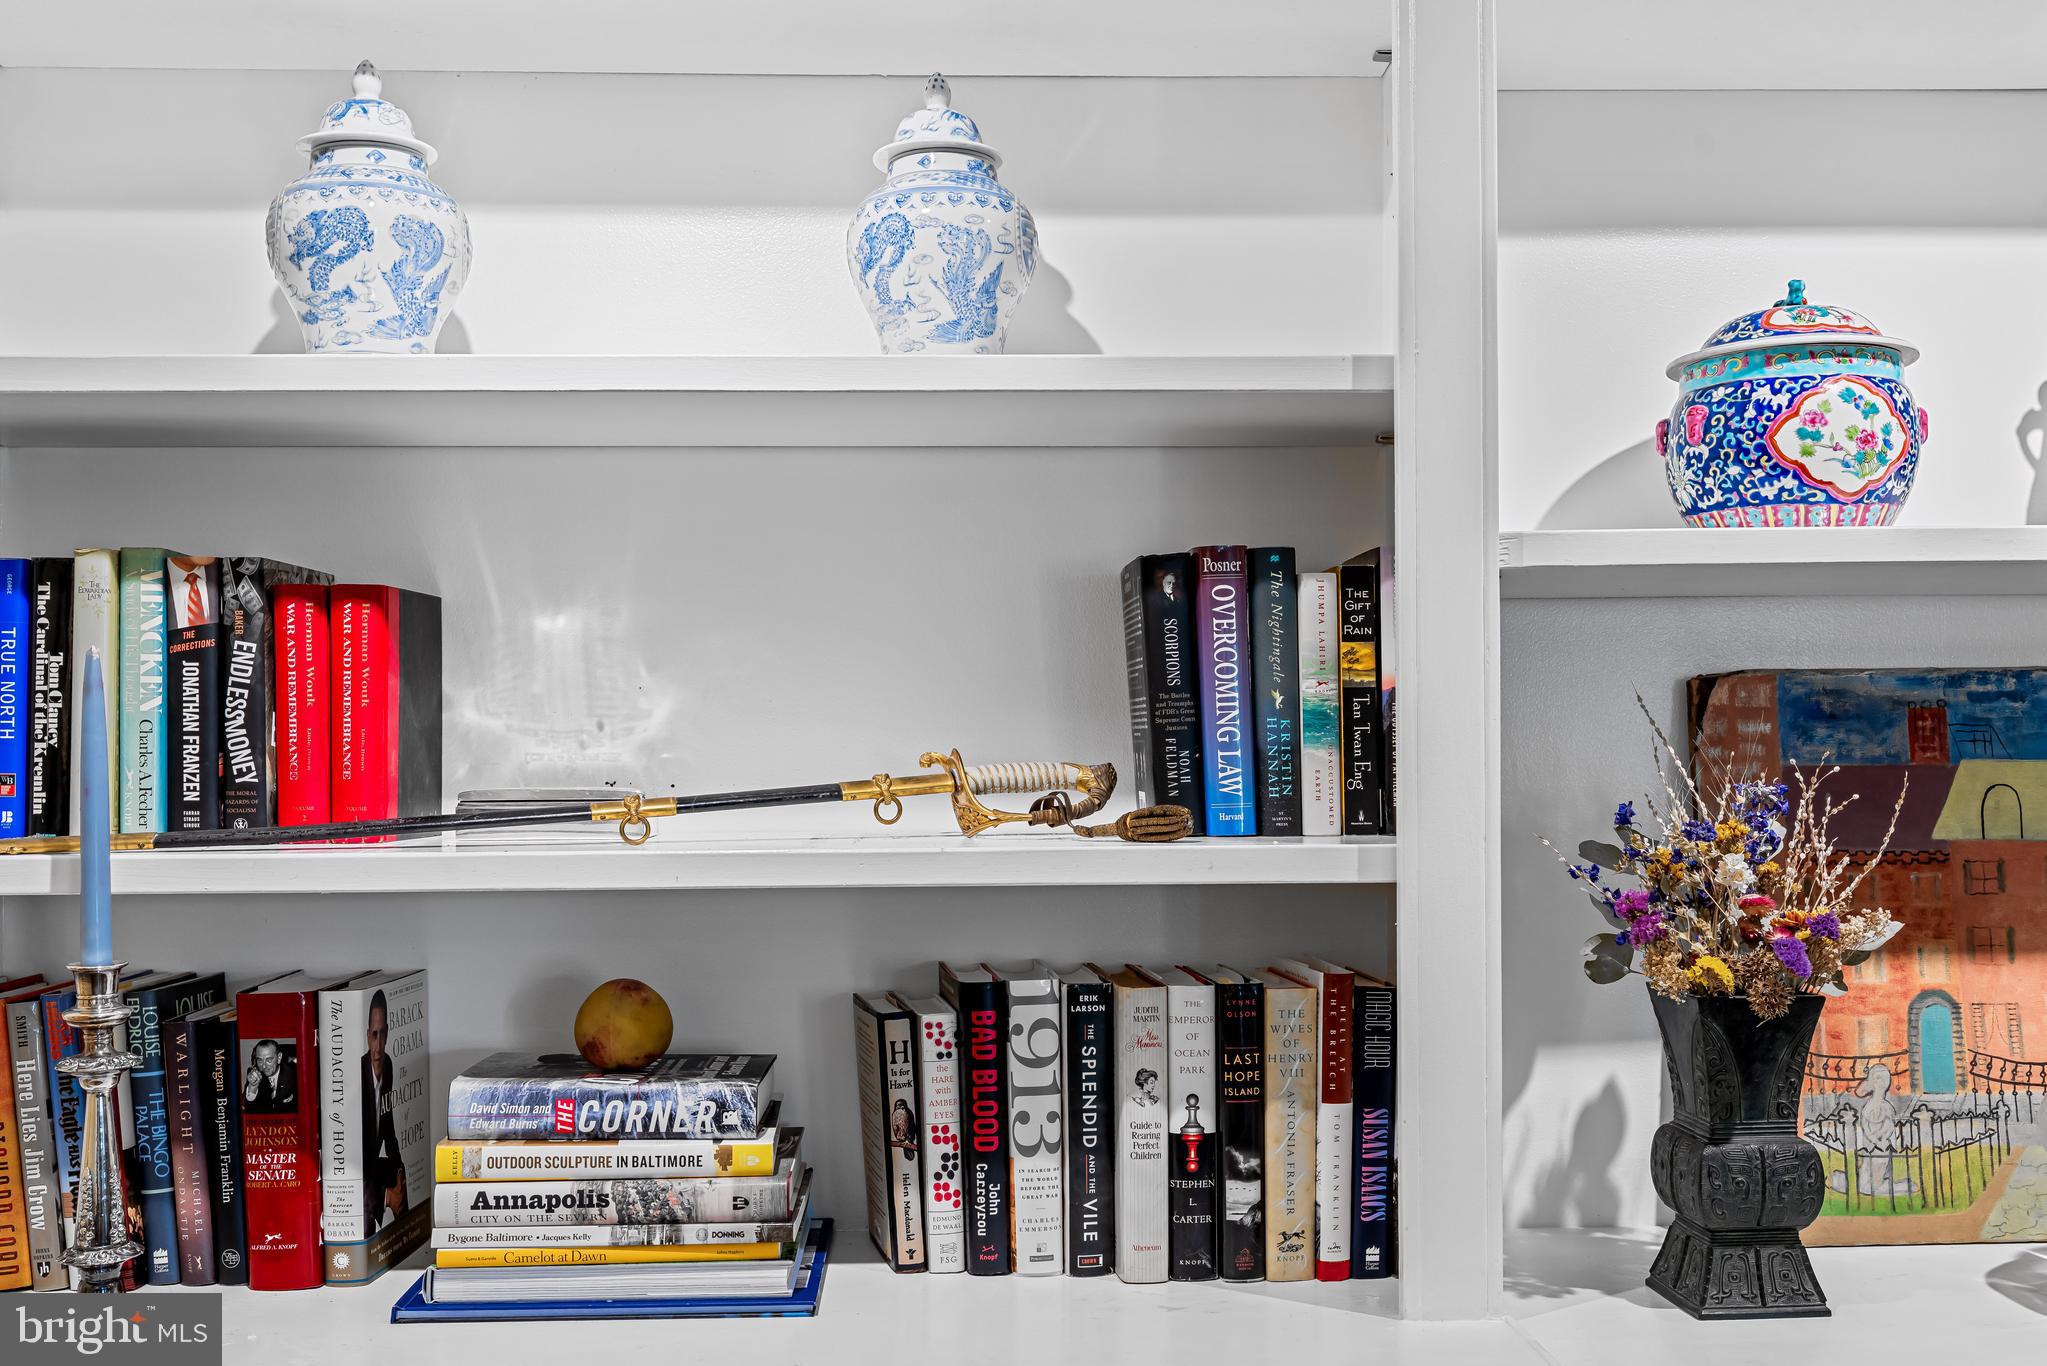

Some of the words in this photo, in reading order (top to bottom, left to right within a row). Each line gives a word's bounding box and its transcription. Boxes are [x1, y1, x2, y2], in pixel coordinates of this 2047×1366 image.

[1202, 557, 1242, 573] Posner
[37, 581, 50, 615] The
[1270, 571, 1283, 598] The
[1346, 588, 1369, 599] THE
[287, 603, 295, 635] WAR
[343, 603, 352, 635] WAR
[1344, 601, 1371, 611] GIFT
[1351, 615, 1365, 623] OF
[182, 630, 196, 640] THE
[234, 609, 244, 635] BAKER
[1344, 625, 1372, 635] RAIN
[1, 627, 16, 674] TRUE
[35, 617, 50, 691] Cardinal
[140, 568, 163, 715] MENCKEN
[169, 638, 216, 654] CORRECTIONS
[287, 640, 296, 667] AND
[343, 639, 352, 668] AND
[1164, 619, 1181, 686] SCORPIONS
[1267, 605, 1284, 683] Nightingale
[49, 652, 63, 689] Tom
[1212, 584, 1240, 742] OVERCOMING
[225, 640, 257, 719] ENDLESS
[0, 682, 15, 739] NORTH
[34, 693, 47, 709] of
[182, 661, 200, 731] JONATHAN
[1167, 701, 1193, 709] Triumphs
[1353, 694, 1370, 719] Tan
[34, 711, 47, 739] the
[48, 690, 62, 748] Clancy
[288, 671, 299, 781] REMEMBRANCE
[342, 671, 352, 780] REMEMBRANCE
[1155, 717, 1179, 725] Supreme
[225, 717, 258, 783] MONEY
[1353, 723, 1371, 757] Twan
[182, 735, 200, 801] FRANZEN
[1165, 738, 1179, 797] FELDMAN
[1182, 750, 1191, 783] NOAH
[1267, 718, 1280, 798] HANNAH
[1280, 719, 1292, 796] KRISTIN
[33, 742, 47, 815] Kremlin
[1216, 749, 1242, 797] LAW
[1347, 762, 1371, 790] Eng
[1219, 813, 1244, 821] Harvard
[389, 1001, 424, 1031] BARACK
[1270, 1024, 1313, 1033] WIVES
[1278, 1009, 1305, 1019] THE
[16, 1016, 28, 1047] SMITH
[143, 1007, 160, 1057] LOUISE
[393, 1031, 424, 1057] OBAMA
[971, 1010, 996, 1060] BAD
[1185, 1033, 1199, 1041] OF
[1283, 1039, 1301, 1048] OF
[890, 1040, 910, 1064] H
[1224, 1053, 1260, 1065] LAST
[1268, 1053, 1314, 1063] HENRY
[1329, 1030, 1337, 1090] BREECH
[16, 1060, 35, 1100] Here
[212, 1049, 225, 1092] Morgan
[1008, 979, 1061, 1157] 1913
[1179, 1066, 1205, 1074] PARK
[1225, 1071, 1260, 1081] HOPE
[149, 1088, 166, 1115] THE
[176, 1033, 193, 1153] WARLIGHT
[929, 1099, 958, 1107] AMBER
[1082, 1046, 1097, 1148] SPLENDID
[1225, 1087, 1260, 1096] ISLAND
[60, 1097, 82, 1144] Eagle
[470, 1103, 496, 1114] David
[500, 1103, 530, 1114] Simon
[534, 1103, 551, 1114] and
[557, 1100, 573, 1131] THE
[578, 1100, 717, 1133] CORNER
[934, 1111, 954, 1119] EYES
[972, 1070, 999, 1152] BLOOD
[1287, 1090, 1295, 1157] ANTONIA
[20, 1105, 40, 1143] Lies
[135, 1106, 151, 1162] PALACE
[215, 1098, 230, 1151] Benjamin
[246, 1126, 297, 1136] LYNDON
[401, 1121, 425, 1150] HOPE
[470, 1119, 506, 1129] Edward
[508, 1119, 538, 1129] Burns
[1131, 1132, 1161, 1140] Rearing
[25, 1149, 44, 1179] Jim
[68, 1145, 80, 1169] HAS
[151, 1121, 170, 1177] BINGO
[246, 1153, 297, 1164] MASTER
[487, 1156, 542, 1169] OUTDOOR
[544, 1156, 613, 1169] SCULPTURE
[616, 1155, 628, 1168] IN
[632, 1155, 704, 1168] BALTIMORE
[1130, 1152, 1161, 1160] Children
[219, 1155, 234, 1203] Franklin
[248, 1169, 297, 1181] SENATE
[1088, 1155, 1096, 1174] AND
[279, 1180, 301, 1188] CARO
[1088, 1178, 1096, 1194] THE
[1170, 1180, 1214, 1188] STEPHEN
[1286, 1162, 1295, 1215] FRASER
[27, 1185, 47, 1230] Crow
[191, 1170, 203, 1235] MICHAEL
[470, 1190, 610, 1213] Annapolis
[988, 1183, 1000, 1216] John
[470, 1216, 499, 1224] CITY
[504, 1215, 521, 1223] ON
[527, 1214, 554, 1222] THE
[558, 1214, 608, 1222] SEVERN
[902, 1200, 915, 1242] Macdonald
[1083, 1198, 1098, 1242] VILE
[1173, 1215, 1212, 1223] CARTER
[448, 1234, 483, 1244] Bygone
[485, 1233, 533, 1242] Baltimore
[541, 1234, 571, 1242] Jacques
[573, 1233, 592, 1241] Kelly
[504, 1251, 555, 1264] Camelot
[558, 1254, 568, 1262] at
[571, 1250, 607, 1262] Dawn
